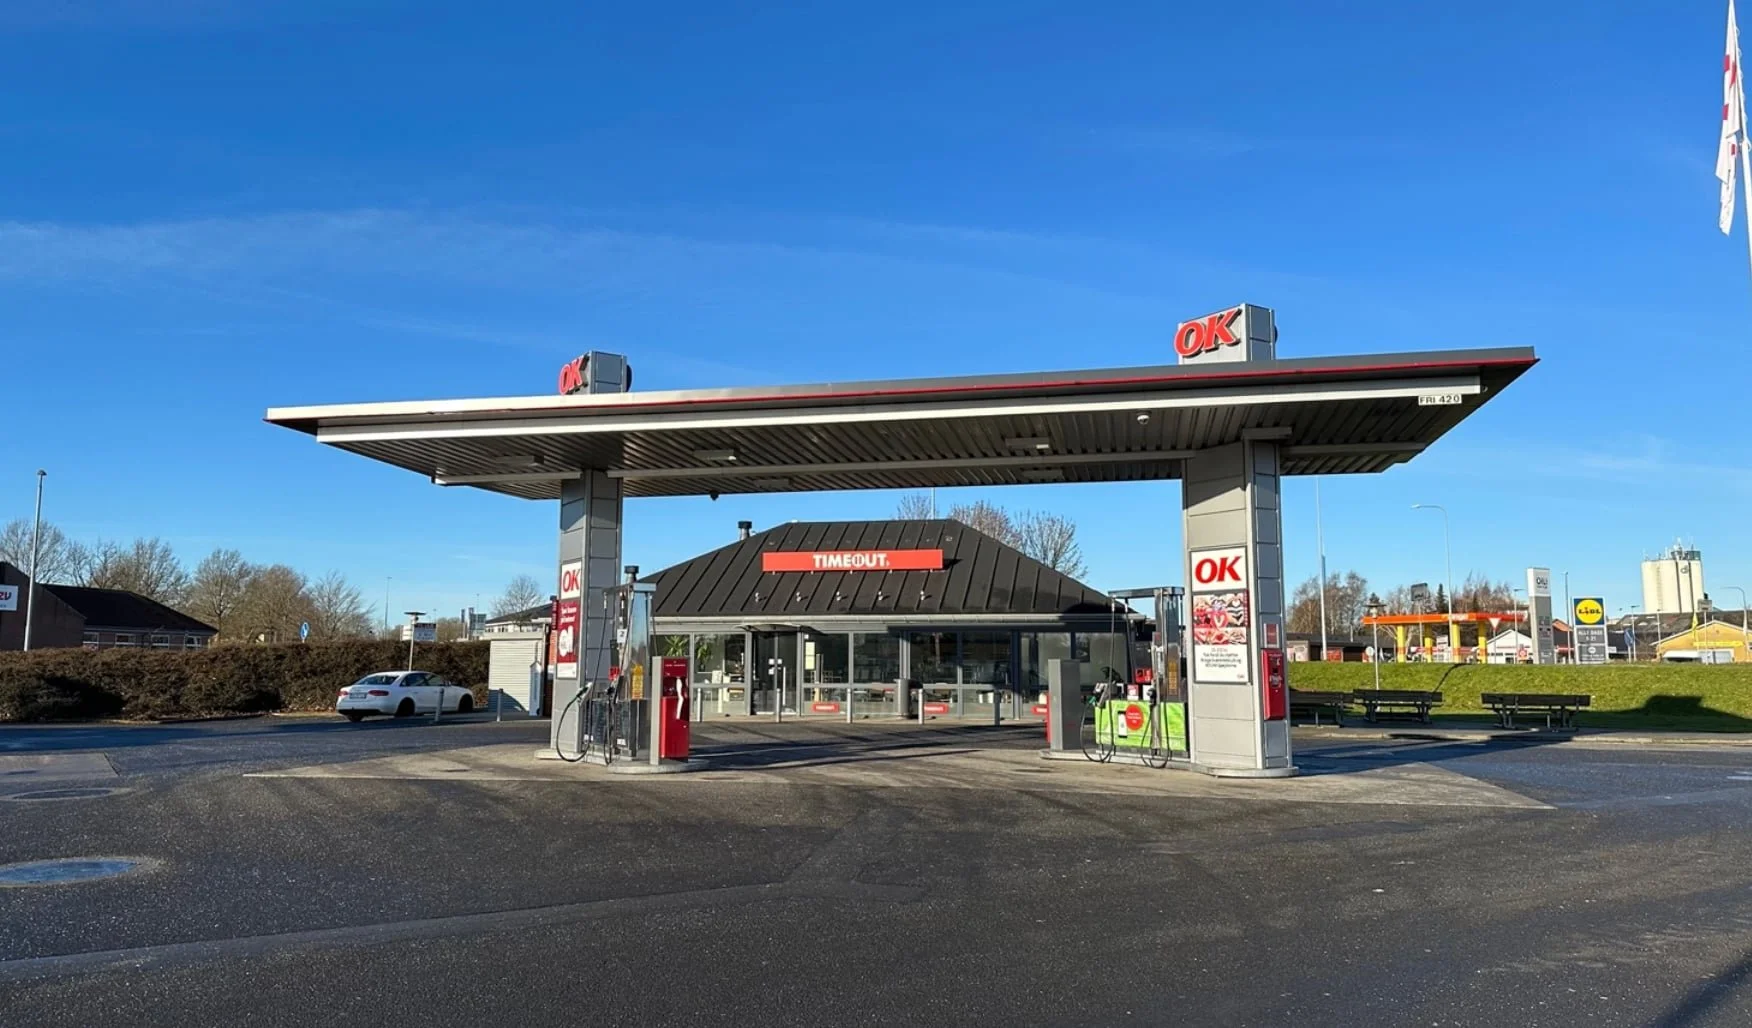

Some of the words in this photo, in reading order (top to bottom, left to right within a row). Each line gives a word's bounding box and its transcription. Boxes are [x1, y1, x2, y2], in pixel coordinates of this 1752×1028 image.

[1174, 308, 1239, 357] OK
[559, 354, 585, 395] OK
[1419, 396, 1436, 404] FRI
[1439, 394, 1460, 403] 420
[813, 553, 887, 568] TIMEOUT
[1195, 555, 1242, 584] OK
[562, 568, 581, 593] OK
